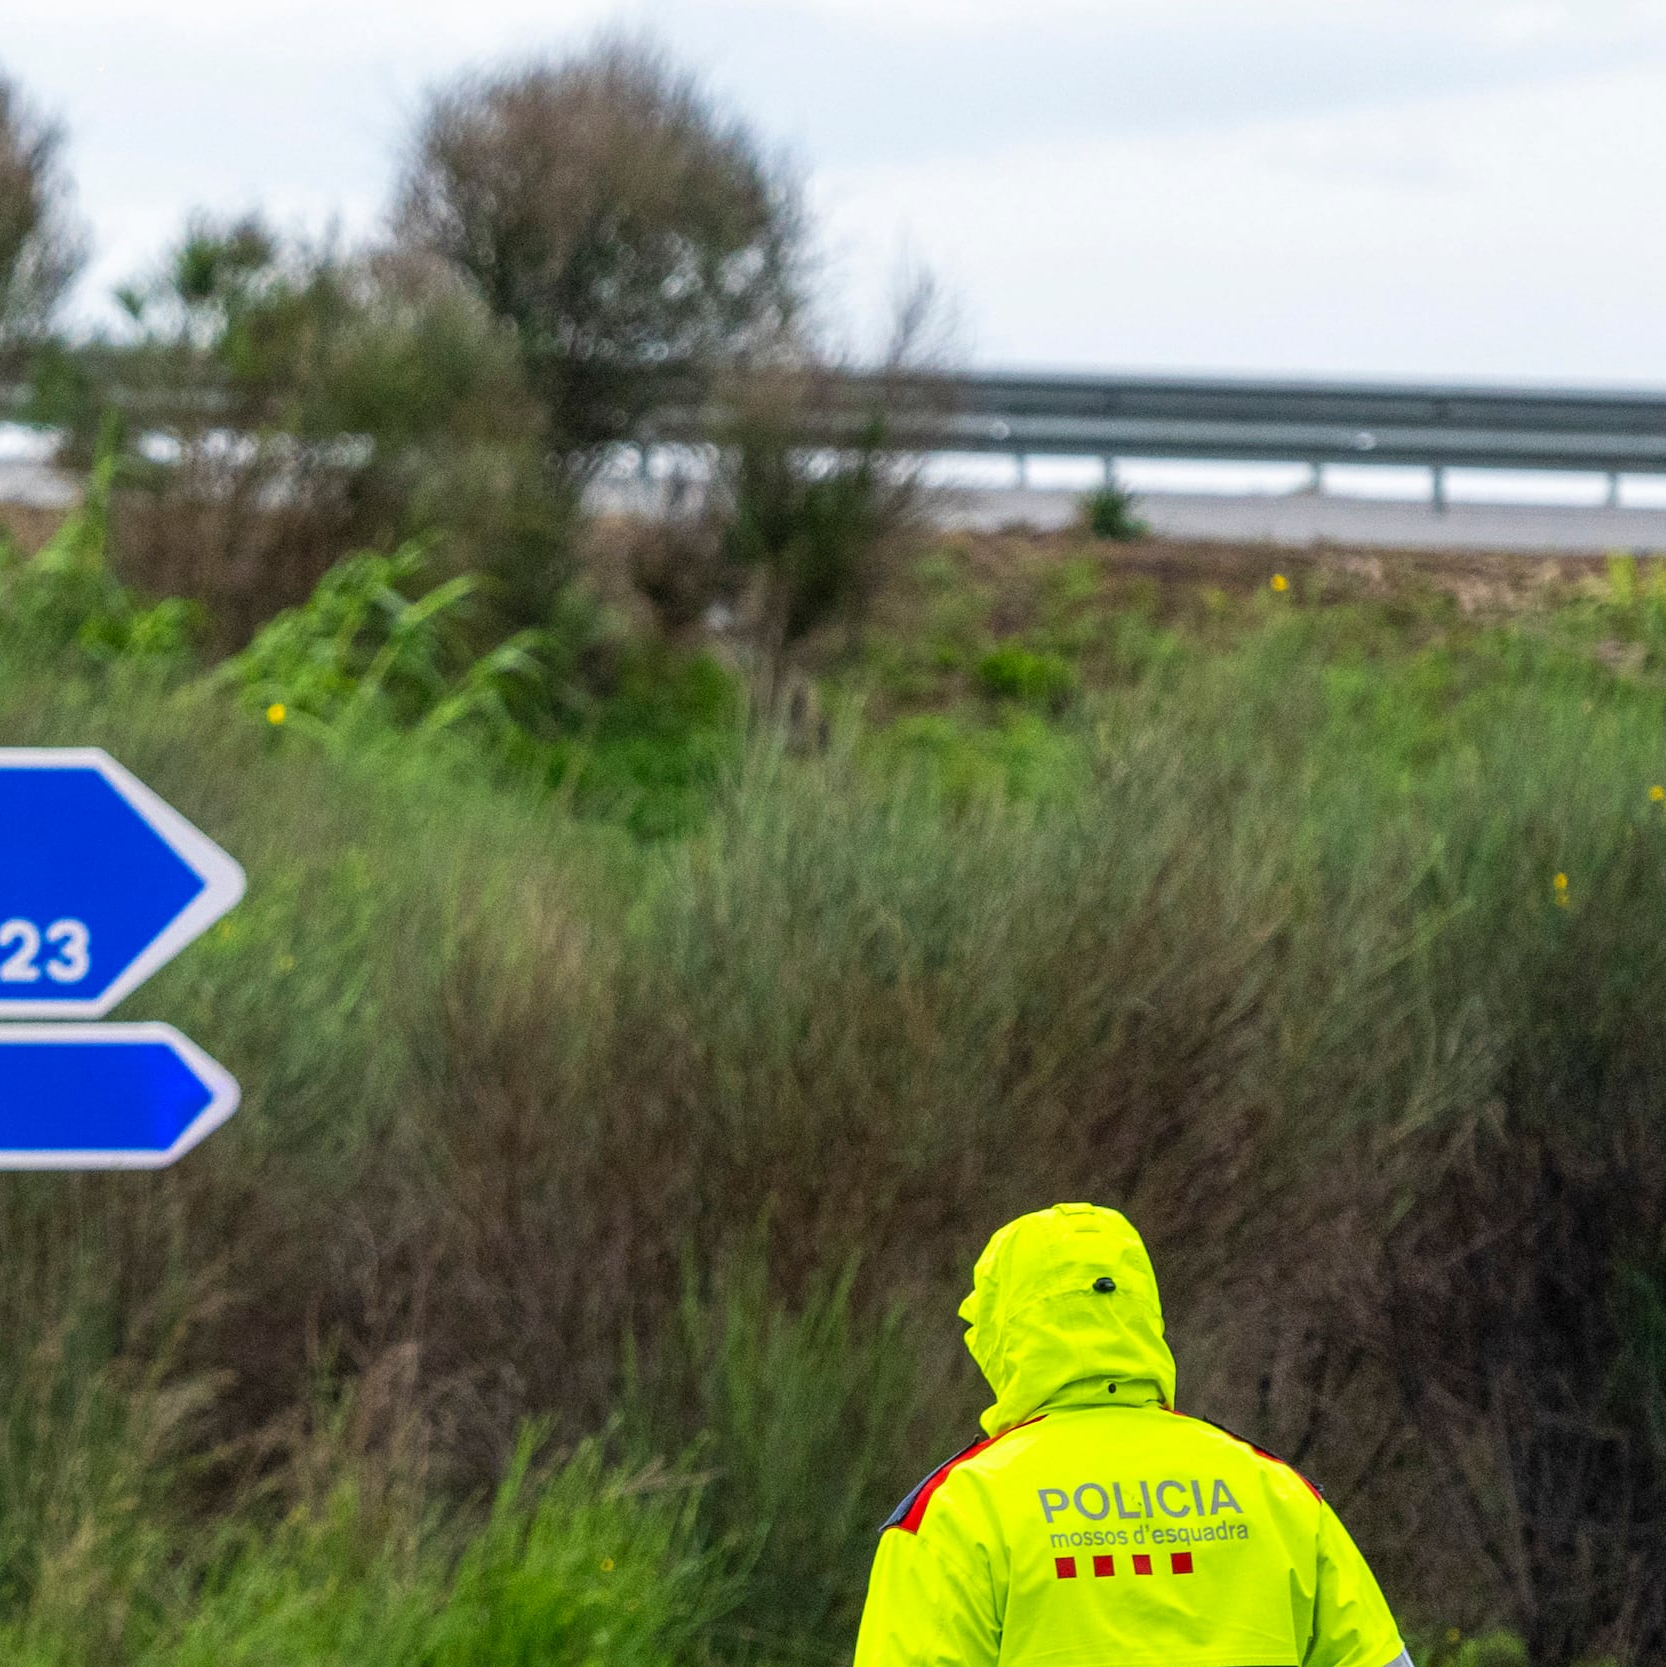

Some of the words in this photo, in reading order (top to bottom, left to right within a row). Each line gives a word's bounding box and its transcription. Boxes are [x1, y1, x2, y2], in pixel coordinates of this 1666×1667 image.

[1037, 1479, 1244, 1524] POLICIA
[1050, 1529, 1129, 1549] mossos
[1133, 1520, 1249, 1546] d'esquadra
